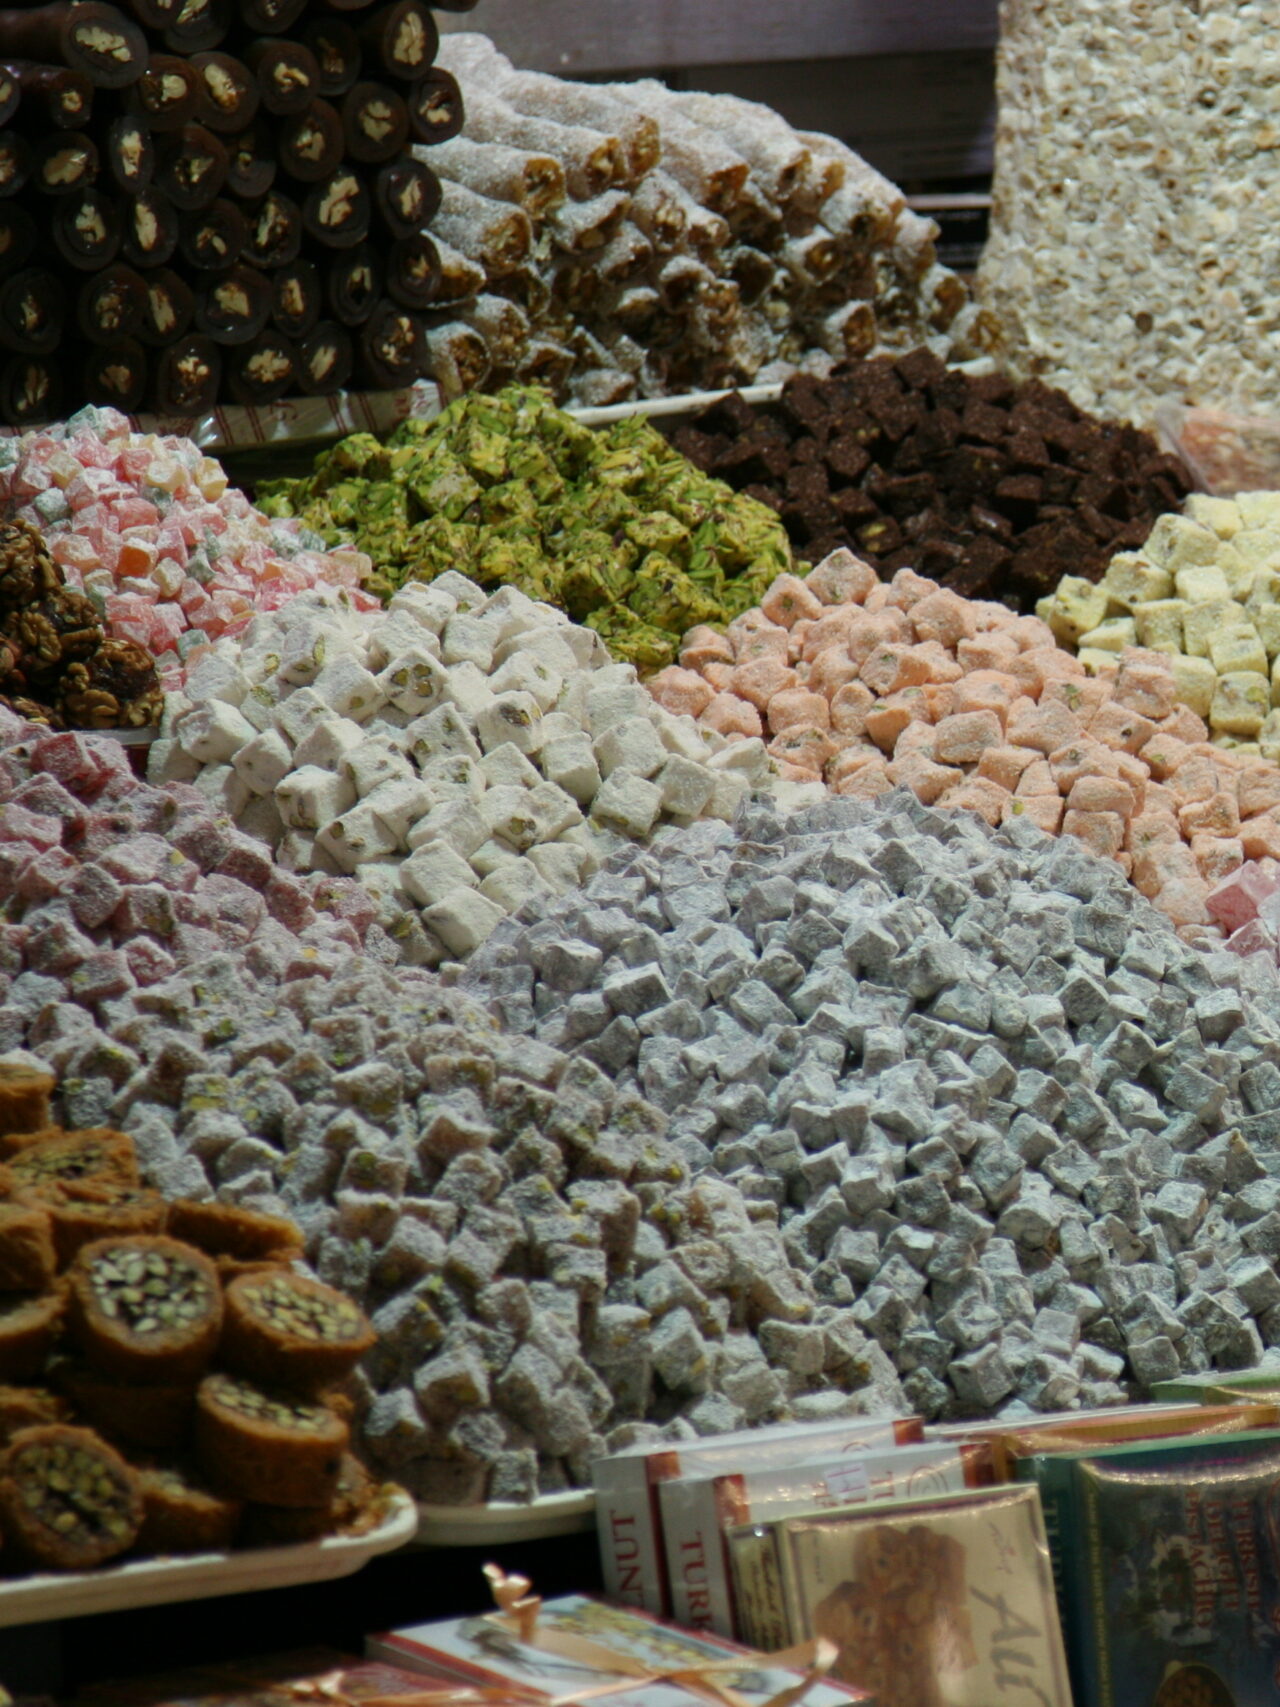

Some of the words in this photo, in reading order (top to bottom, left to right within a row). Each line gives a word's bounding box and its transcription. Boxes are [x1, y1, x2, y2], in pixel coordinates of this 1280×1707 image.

[1184, 1491, 1214, 1628] PISTACHIO
[1208, 1500, 1236, 1611] DELIGHT
[1233, 1499, 1258, 1608] TURKISH
